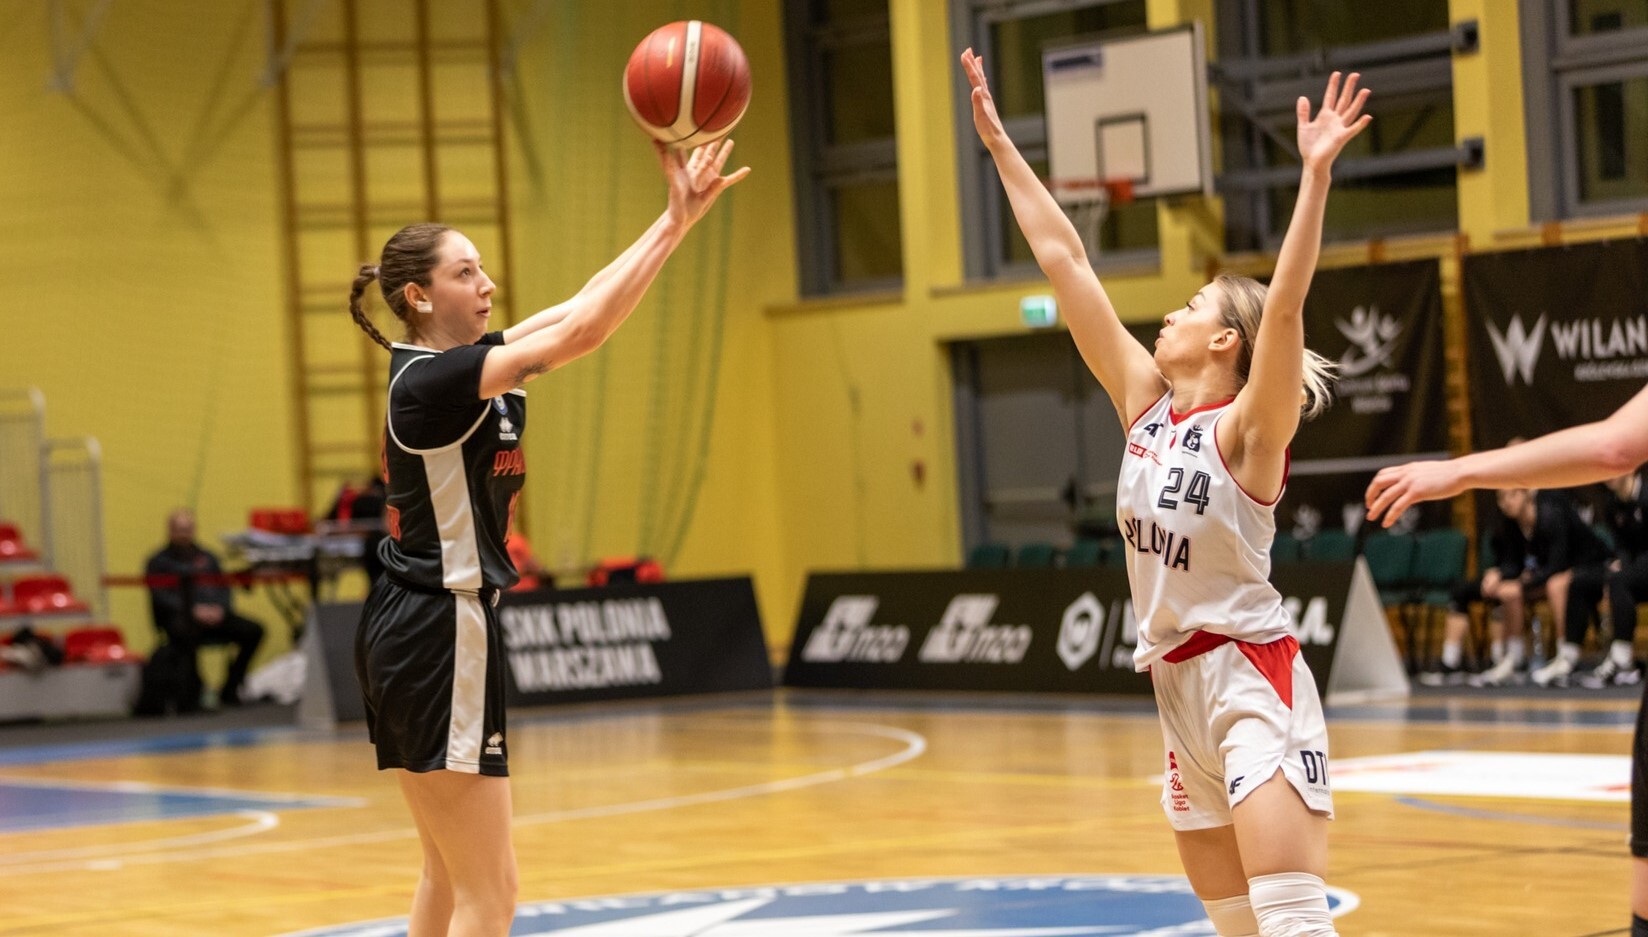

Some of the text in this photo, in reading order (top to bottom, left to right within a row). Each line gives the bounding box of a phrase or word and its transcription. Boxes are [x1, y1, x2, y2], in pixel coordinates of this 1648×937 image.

[1157, 467, 1212, 516] 24
[502, 596, 672, 651] SKK POLONIA
[509, 643, 664, 693] WARSZAWA
